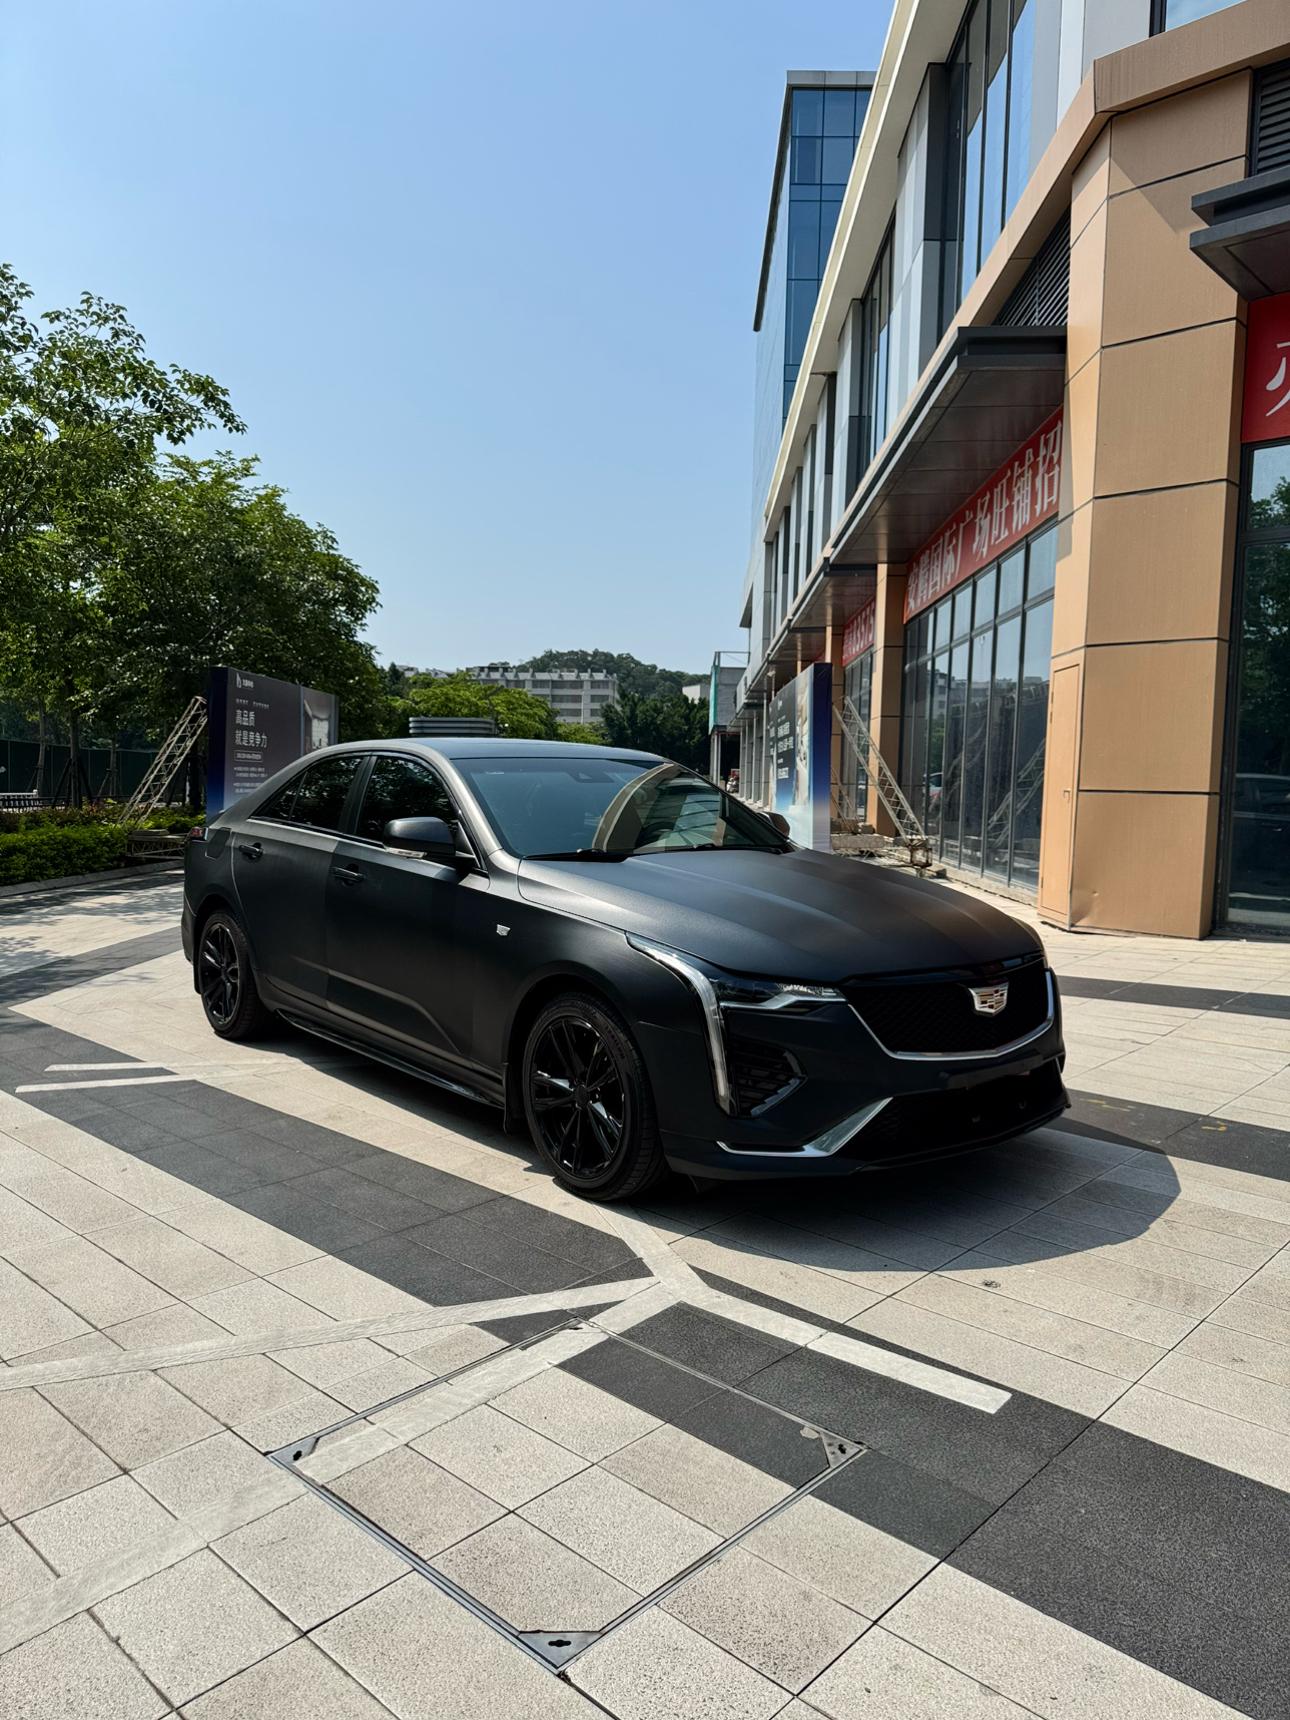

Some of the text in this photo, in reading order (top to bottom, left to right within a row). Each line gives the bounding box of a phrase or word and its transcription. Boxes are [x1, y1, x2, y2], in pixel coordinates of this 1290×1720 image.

[235, 709, 255, 727] 高品质
[235, 730, 267, 748] 就是竞争力
